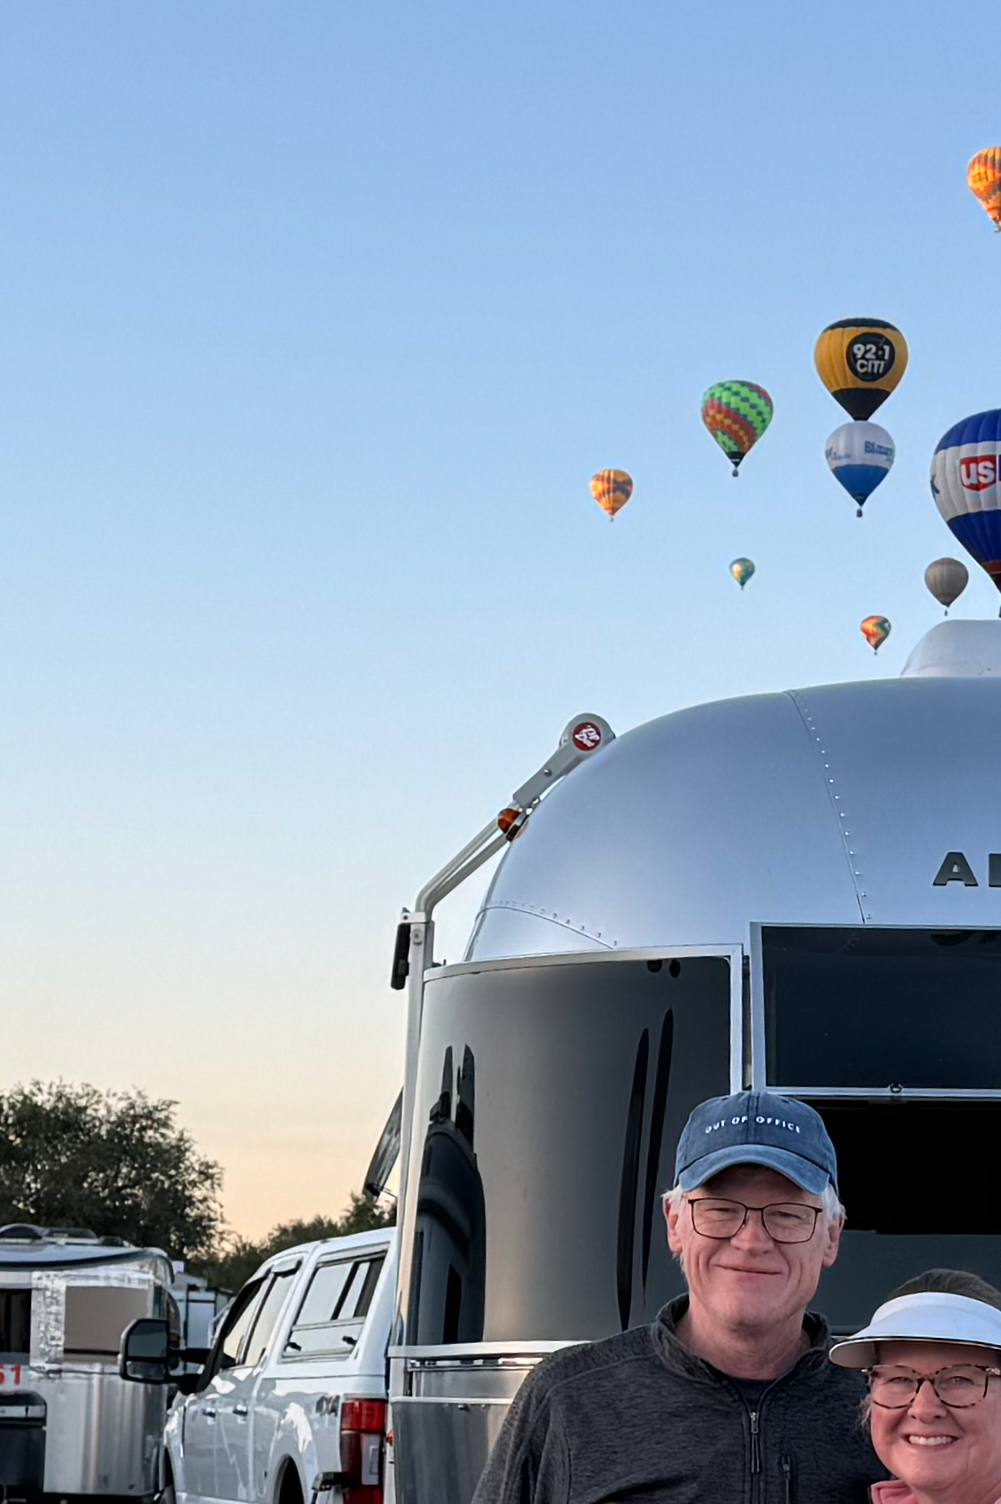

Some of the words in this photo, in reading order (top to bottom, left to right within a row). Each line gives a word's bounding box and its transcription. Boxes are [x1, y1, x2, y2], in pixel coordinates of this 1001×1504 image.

[705, 1119, 726, 1134] OUT
[731, 1115, 748, 1125] OF
[755, 1115, 801, 1134] OFFICE
